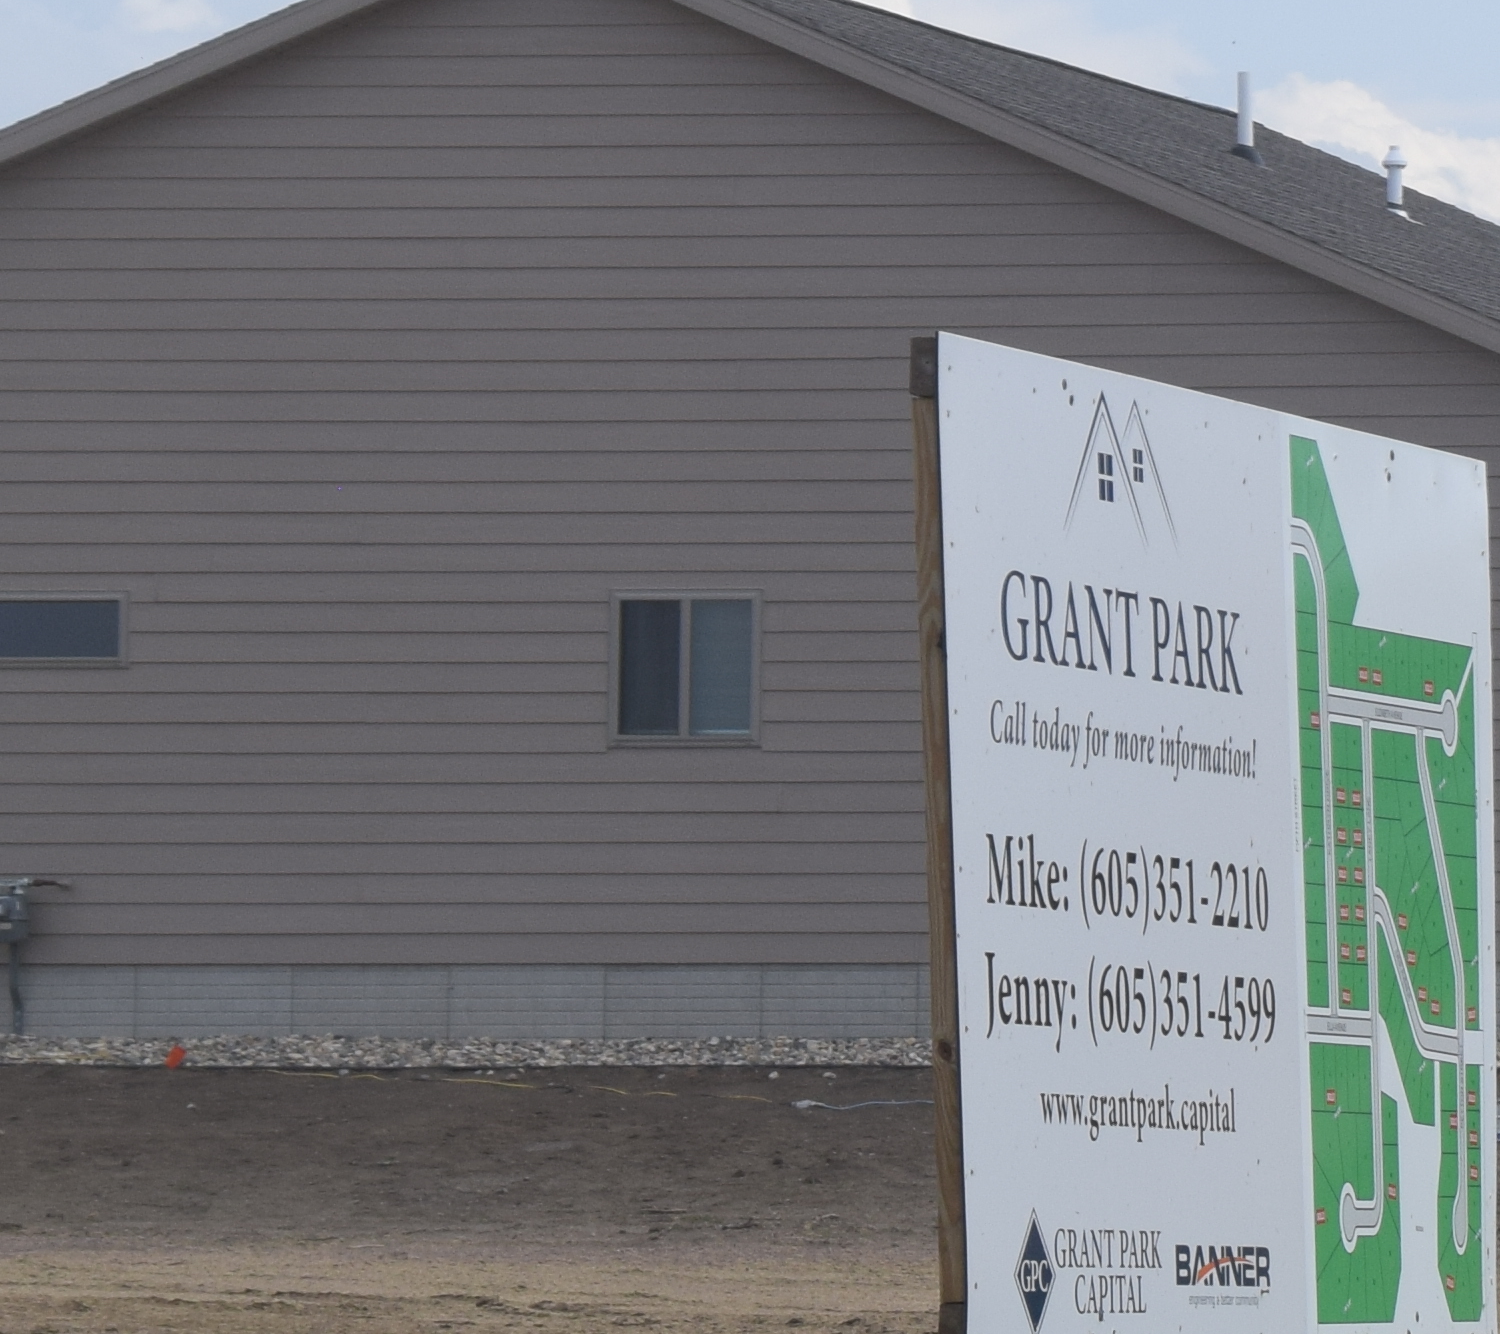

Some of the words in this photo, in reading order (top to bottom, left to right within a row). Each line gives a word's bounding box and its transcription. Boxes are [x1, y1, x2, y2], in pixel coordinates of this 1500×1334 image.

[1000, 569, 1139, 677] GRANT
[1149, 596, 1243, 695] PARK
[990, 699, 1026, 746] Call
[1032, 706, 1080, 767] today
[1082, 710, 1109, 769] for
[1114, 730, 1154, 764] more
[1159, 724, 1257, 782] information!
[985, 833, 1069, 912] Mike:
[984, 951, 1077, 1053] Jenny:
[1040, 1083, 1236, 1146] www.grantpark.capital
[1020, 1259, 1048, 1293] GPC
[1054, 1228, 1115, 1269] GRANT
[1119, 1230, 1163, 1269] PARK
[1175, 1244, 1271, 1287] BANNER
[1074, 1274, 1147, 1314] CAPITAL
